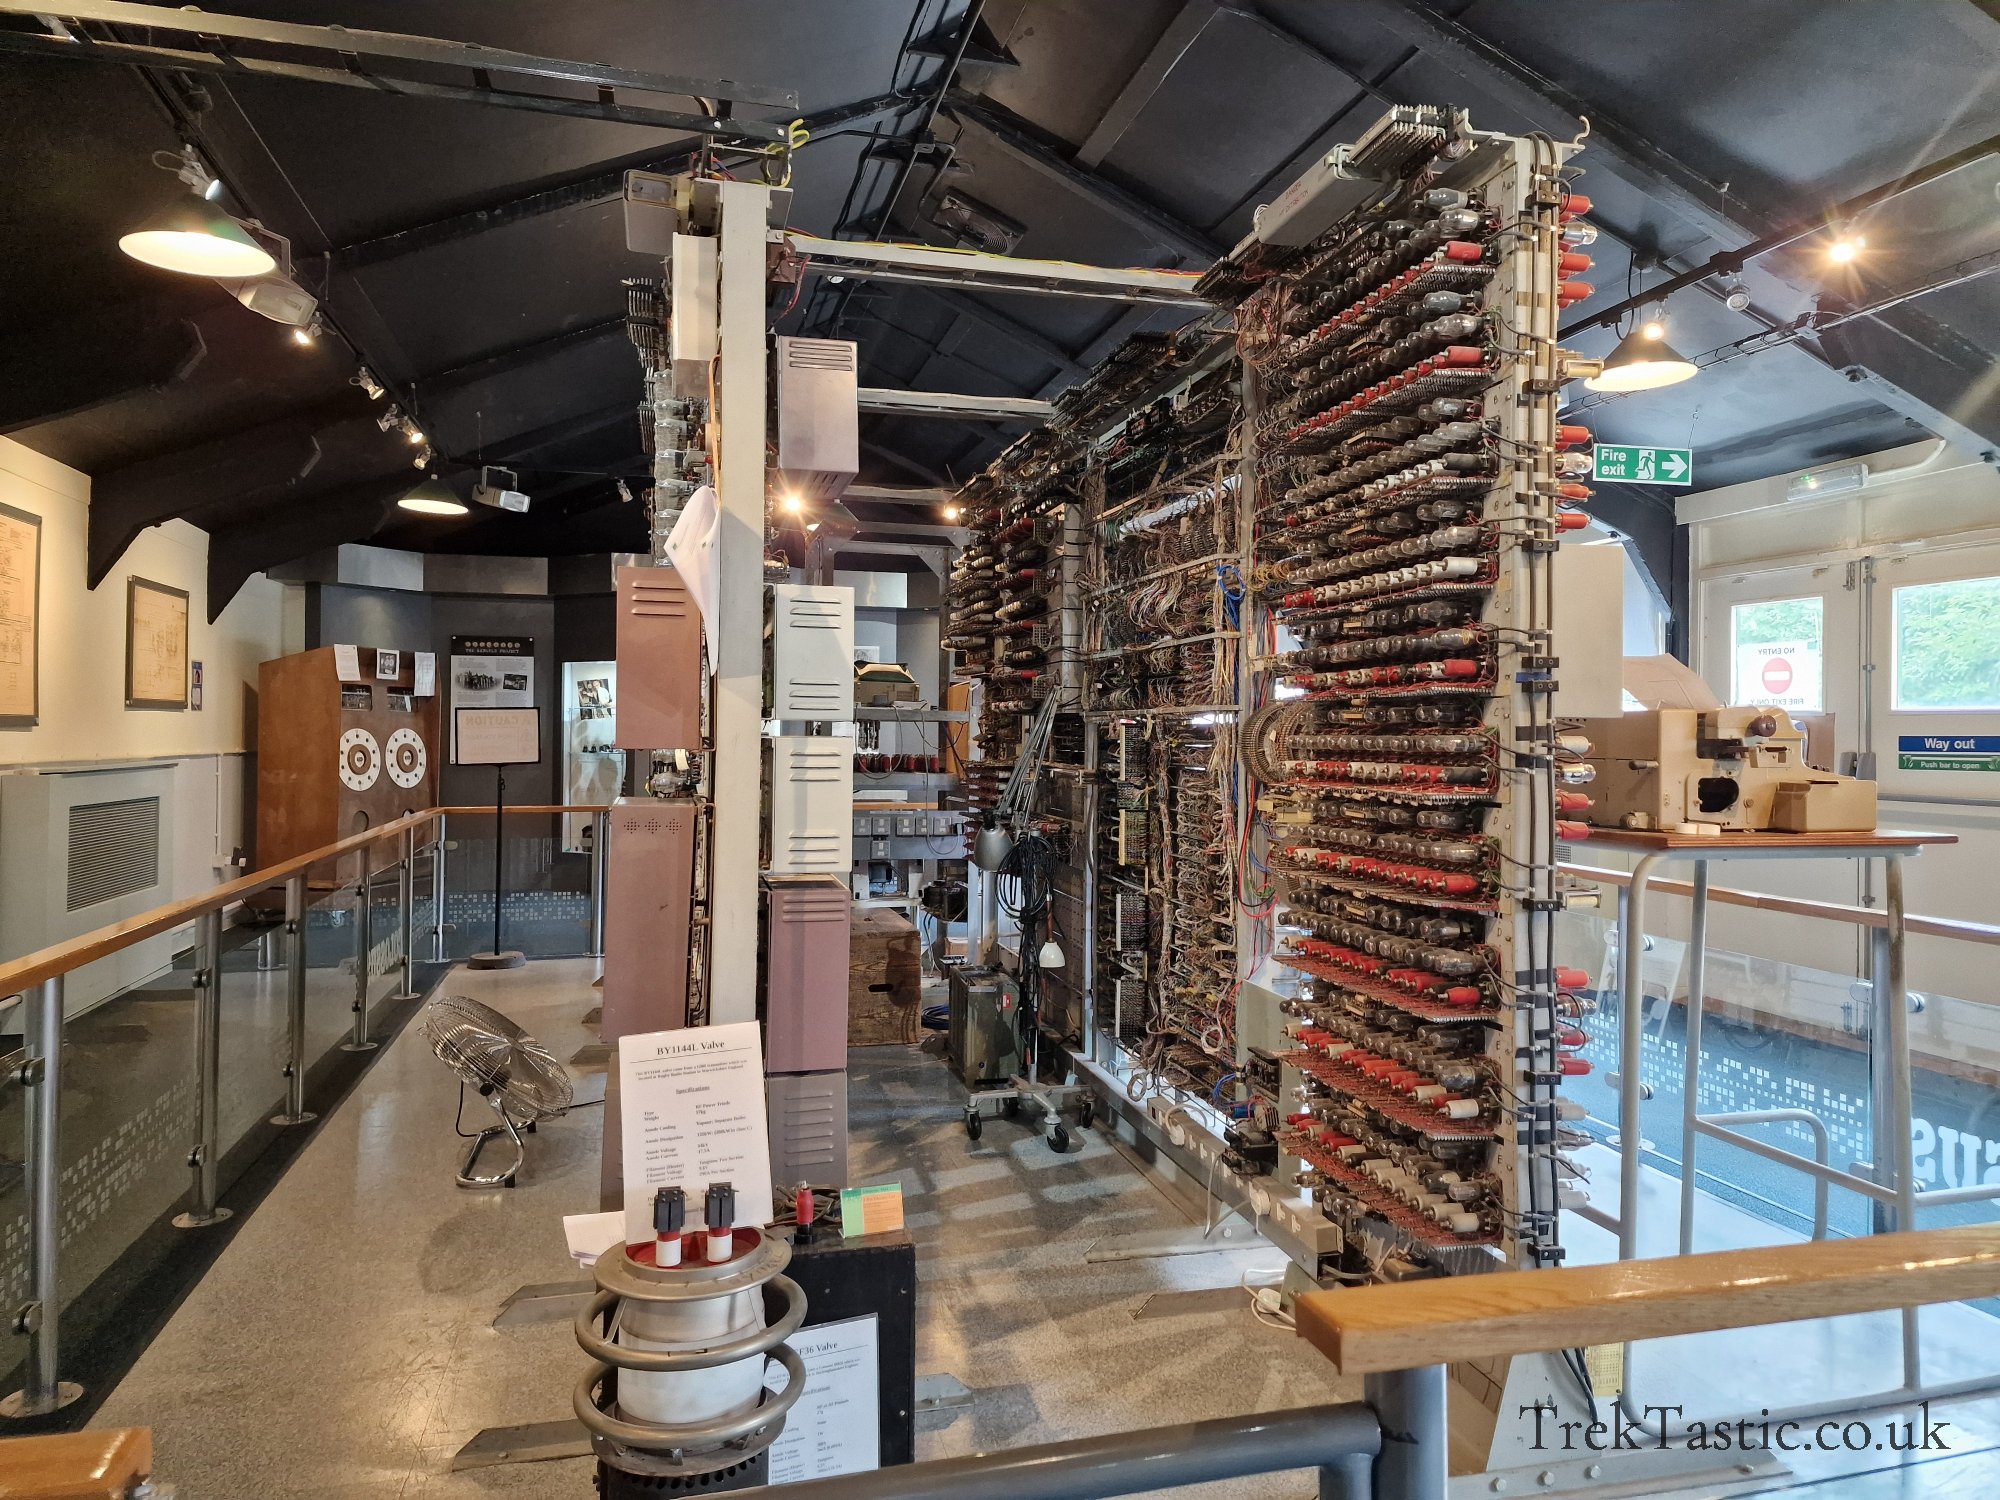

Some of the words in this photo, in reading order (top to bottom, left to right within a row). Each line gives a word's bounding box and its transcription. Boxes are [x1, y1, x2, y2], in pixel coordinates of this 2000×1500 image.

[1601, 449, 1627, 462] Fire
[1601, 463, 1626, 476] exit
[1924, 738, 1950, 751] Way
[1954, 738, 1976, 749] out
[657, 1045, 699, 1056] BY1144L
[700, 1041, 725, 1051] Valve
[796, 1347, 814, 1356] F36
[816, 1342, 838, 1352] Valve
